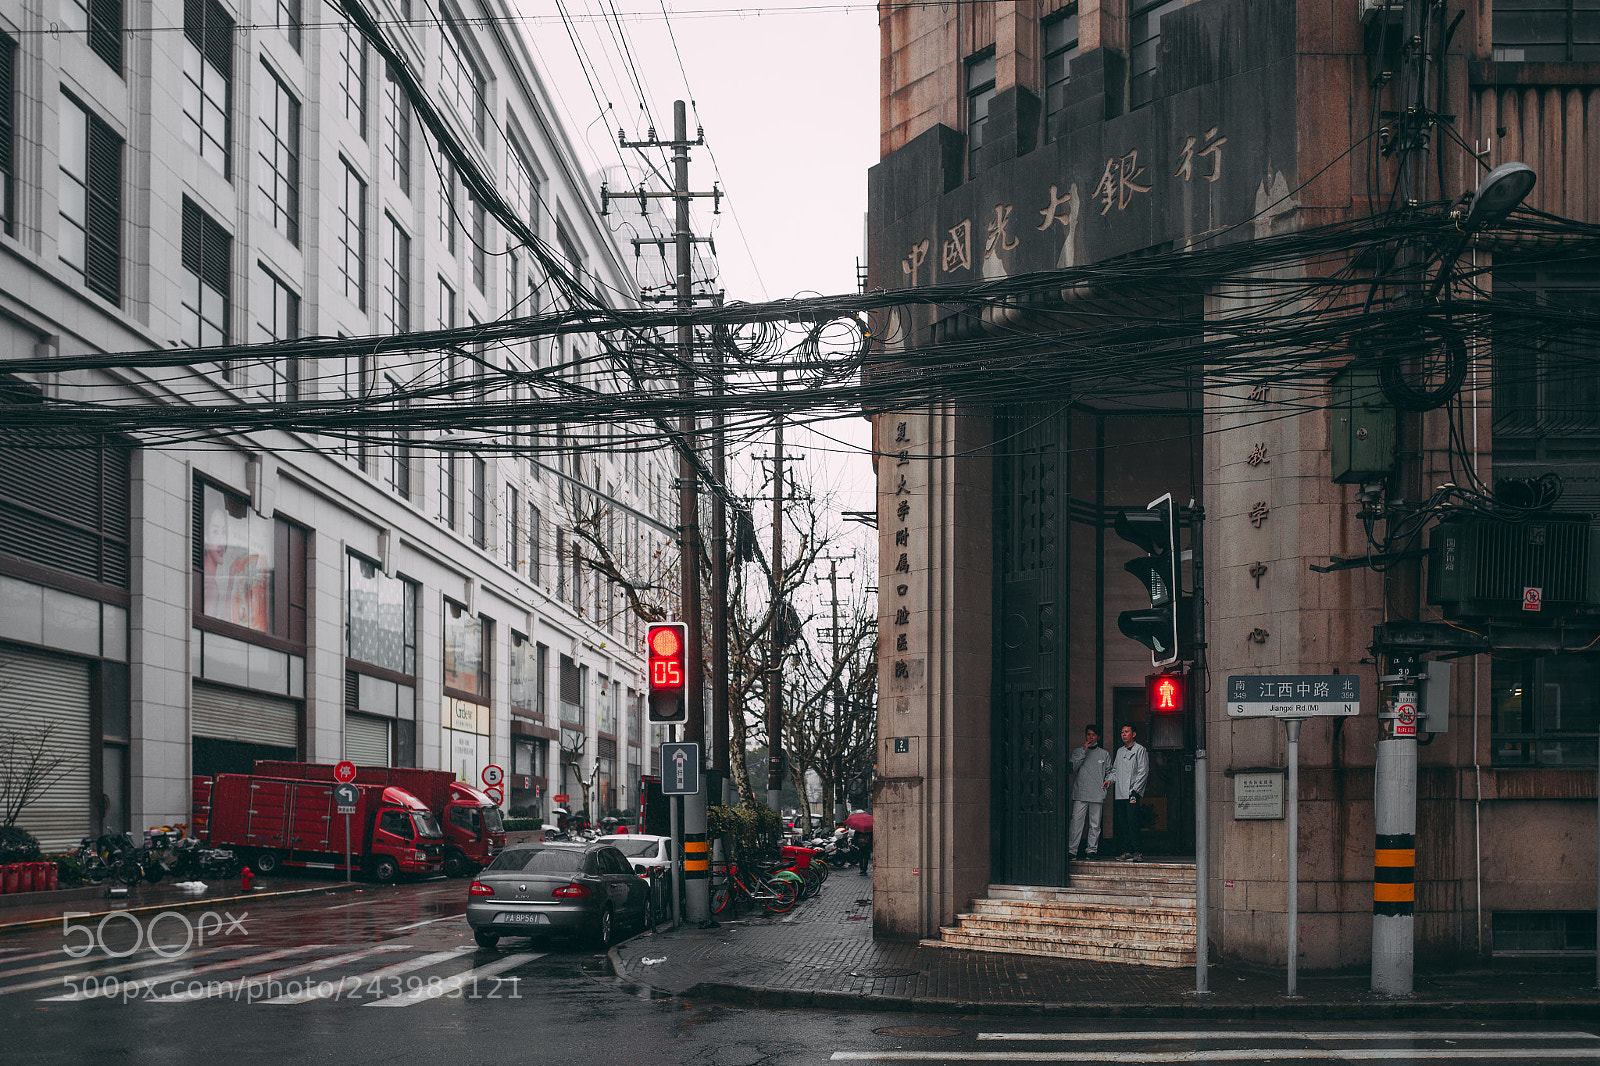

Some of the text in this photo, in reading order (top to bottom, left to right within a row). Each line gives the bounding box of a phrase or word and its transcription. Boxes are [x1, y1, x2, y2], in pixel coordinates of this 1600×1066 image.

[902, 125, 1228, 287] 中國光大銀行
[1247, 321, 1270, 644] 研教学中心
[895, 421, 911, 679] 复旦大学附属口腔医院
[654, 661, 680, 684] 05
[1235, 678, 1353, 698] 南 江西中路 北
[1236, 704, 1244, 713] S
[1269, 704, 1293, 714] Jiangxi
[1344, 704, 1352, 712] N
[899, 740, 904, 749] 2
[339, 766, 351, 778] 停
[489, 771, 497, 780] 5
